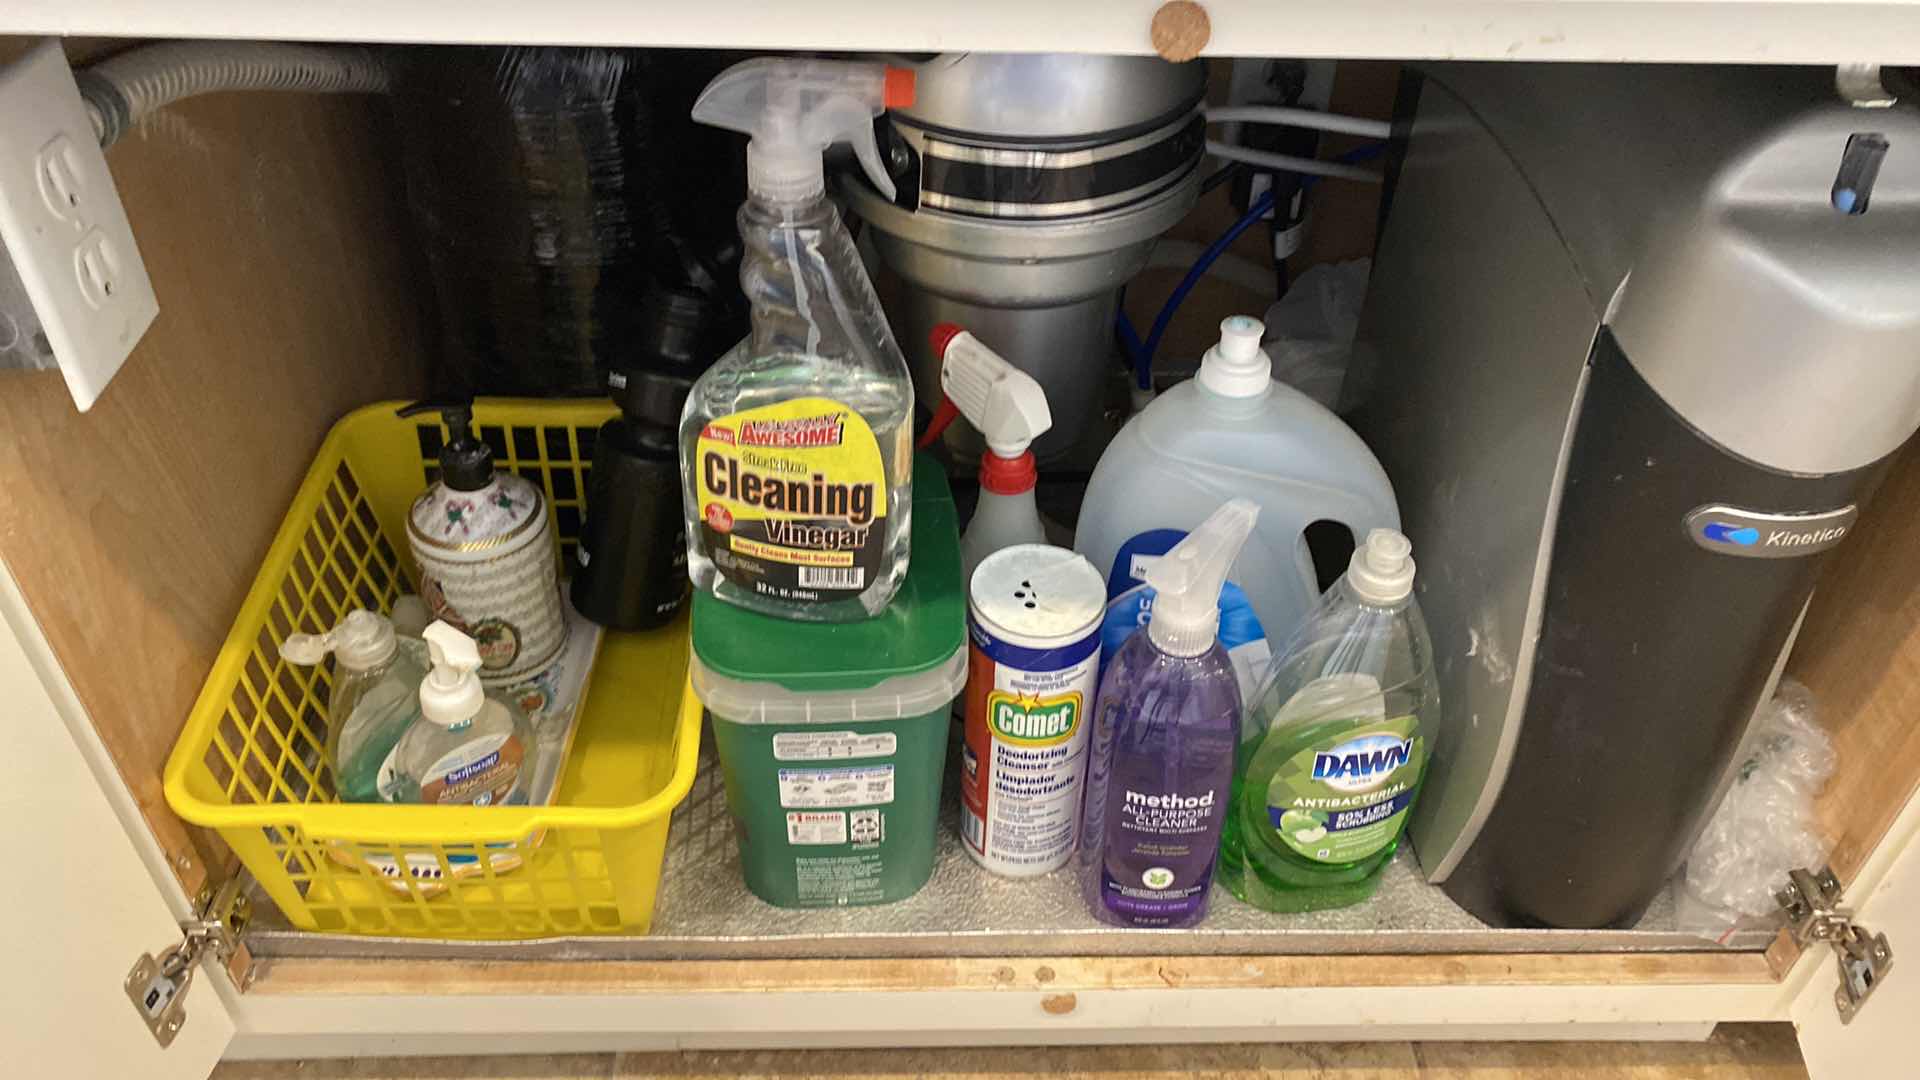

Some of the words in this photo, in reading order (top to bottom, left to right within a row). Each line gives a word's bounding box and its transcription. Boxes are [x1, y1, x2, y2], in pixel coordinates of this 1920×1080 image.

[704, 451, 873, 524] Cleaning
[764, 517, 868, 551] Vinegar
[1765, 526, 1845, 547] Kinetico
[790, 549, 811, 562] Most
[998, 703, 1071, 738] Comet
[997, 745, 1068, 760] Deodorizing
[1312, 738, 1413, 780] DAWN
[997, 756, 1049, 770] Cleanser
[995, 775, 1075, 796] desodorizante
[996, 770, 1056, 785] Limpiador
[1126, 790, 1214, 809] method
[1293, 781, 1407, 808] ANTIBACTERIAL
[1122, 803, 1212, 820] ALL-PURPOSE
[1135, 814, 1197, 829] CLEANER
